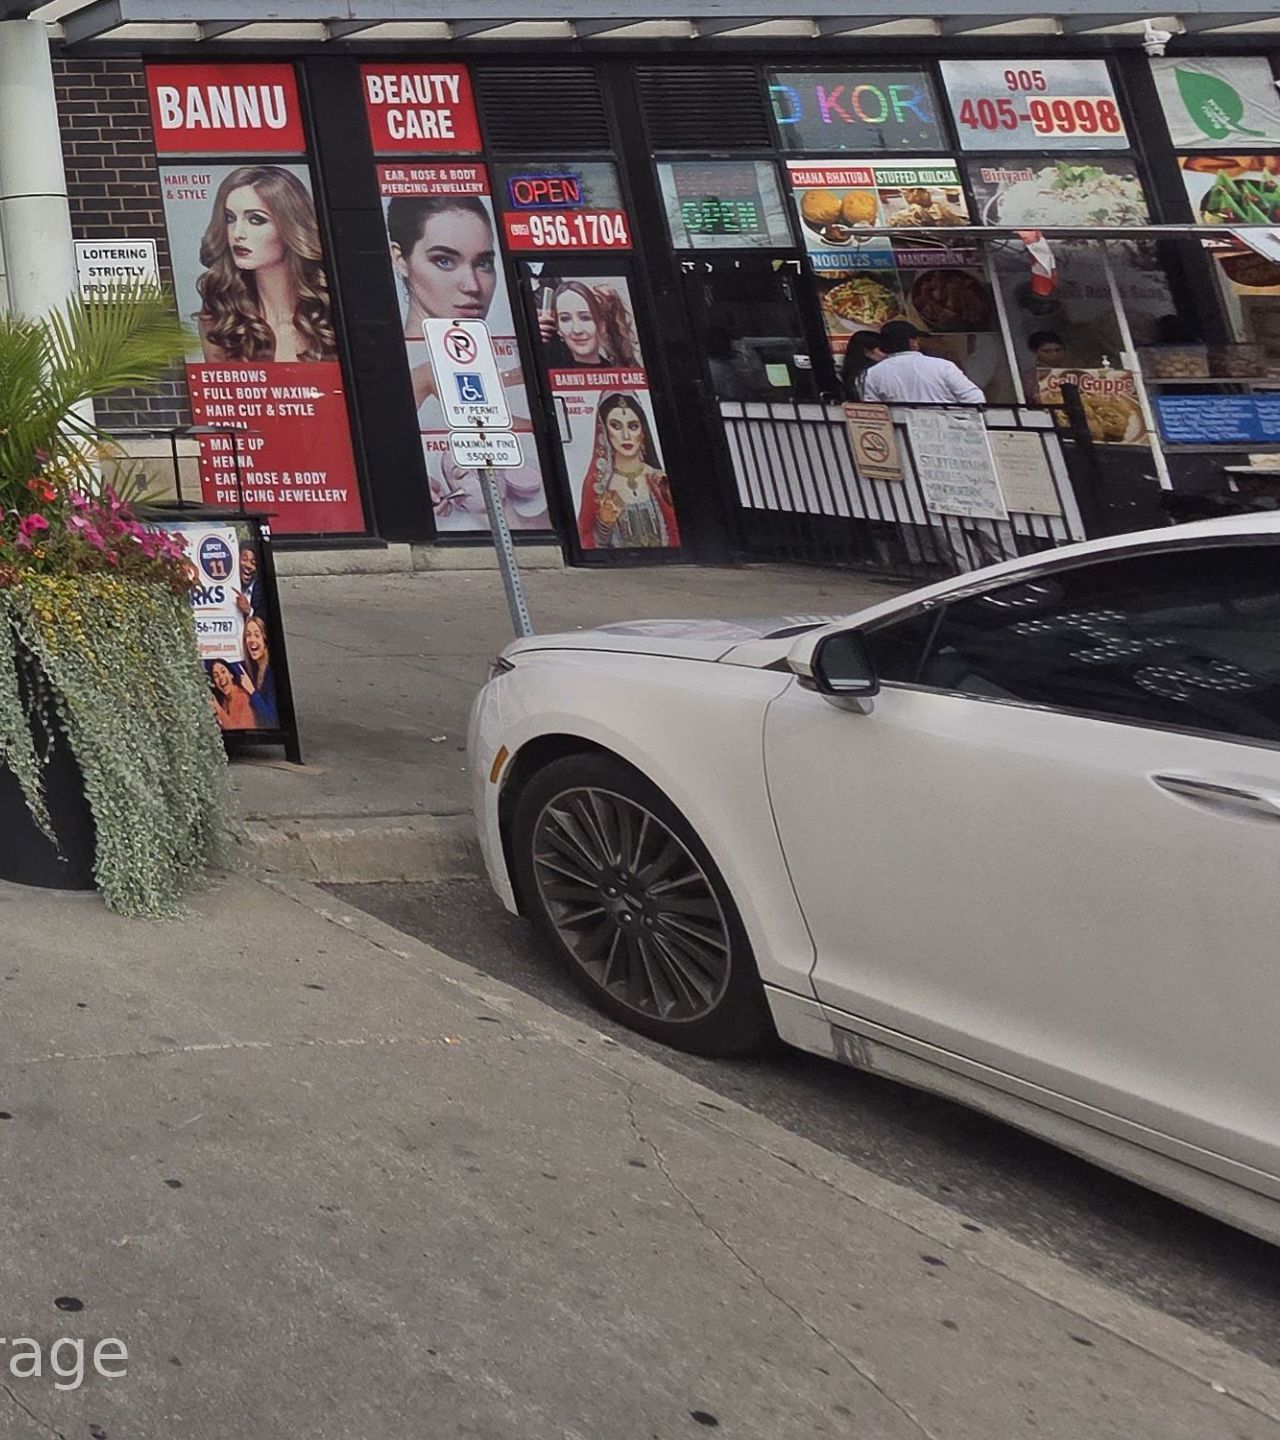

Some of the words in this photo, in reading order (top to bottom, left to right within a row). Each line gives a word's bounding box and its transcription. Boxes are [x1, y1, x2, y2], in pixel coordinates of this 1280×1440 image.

[1004, 69, 1047, 91] 905
[366, 74, 460, 104] BEAUTY
[157, 85, 287, 129] BANNU
[816, 85, 934, 124] KOR
[959, 99, 1121, 134] 405-9998
[387, 109, 455, 139] CARE
[164, 175, 188, 185] HAIR
[191, 175, 211, 184] CUT
[385, 170, 409, 182] EAR,
[411, 170, 437, 181] NOSE
[440, 170, 448, 181] &
[450, 169, 476, 181] BODY
[792, 170, 825, 185] CHANA
[826, 170, 871, 185] BHATURA
[876, 169, 917, 184] STUFFED
[919, 170, 957, 184] KULCHA
[980, 167, 1033, 185] Biriyani
[167, 190, 174, 199] &
[178, 189, 207, 200] STYLE
[381, 184, 429, 194] PIERCING
[431, 183, 484, 194] JEWELLERY
[514, 179, 580, 205] OPEN
[681, 202, 759, 233] OPEN
[529, 214, 628, 247] 956.1704
[83, 249, 147, 259] LOITERING
[811, 252, 870, 267] NOODLES
[88, 266, 145, 277] STRICTLY
[201, 370, 267, 383] EYEBROWS
[555, 374, 585, 386] BANNU
[587, 373, 620, 386] BEAUTY
[621, 373, 646, 386] CARE
[204, 387, 233, 400] FULL
[237, 387, 268, 400] BODY
[270, 386, 319, 400] WAXING
[206, 404, 236, 417] HAIR
[240, 404, 263, 416] CUT
[266, 404, 275, 416] &
[278, 403, 315, 416] STYLE
[453, 406, 467, 415] BY
[469, 406, 499, 415] PERMIT
[248, 438, 265, 451] UP
[453, 440, 493, 449] MAXIMUM
[496, 440, 516, 449] FINE
[247, 472, 279, 485] NOSE
[282, 472, 291, 485] &
[295, 472, 327, 485] BODY
[278, 489, 348, 502] JEWELLERY
[209, 560, 228, 577] 11
